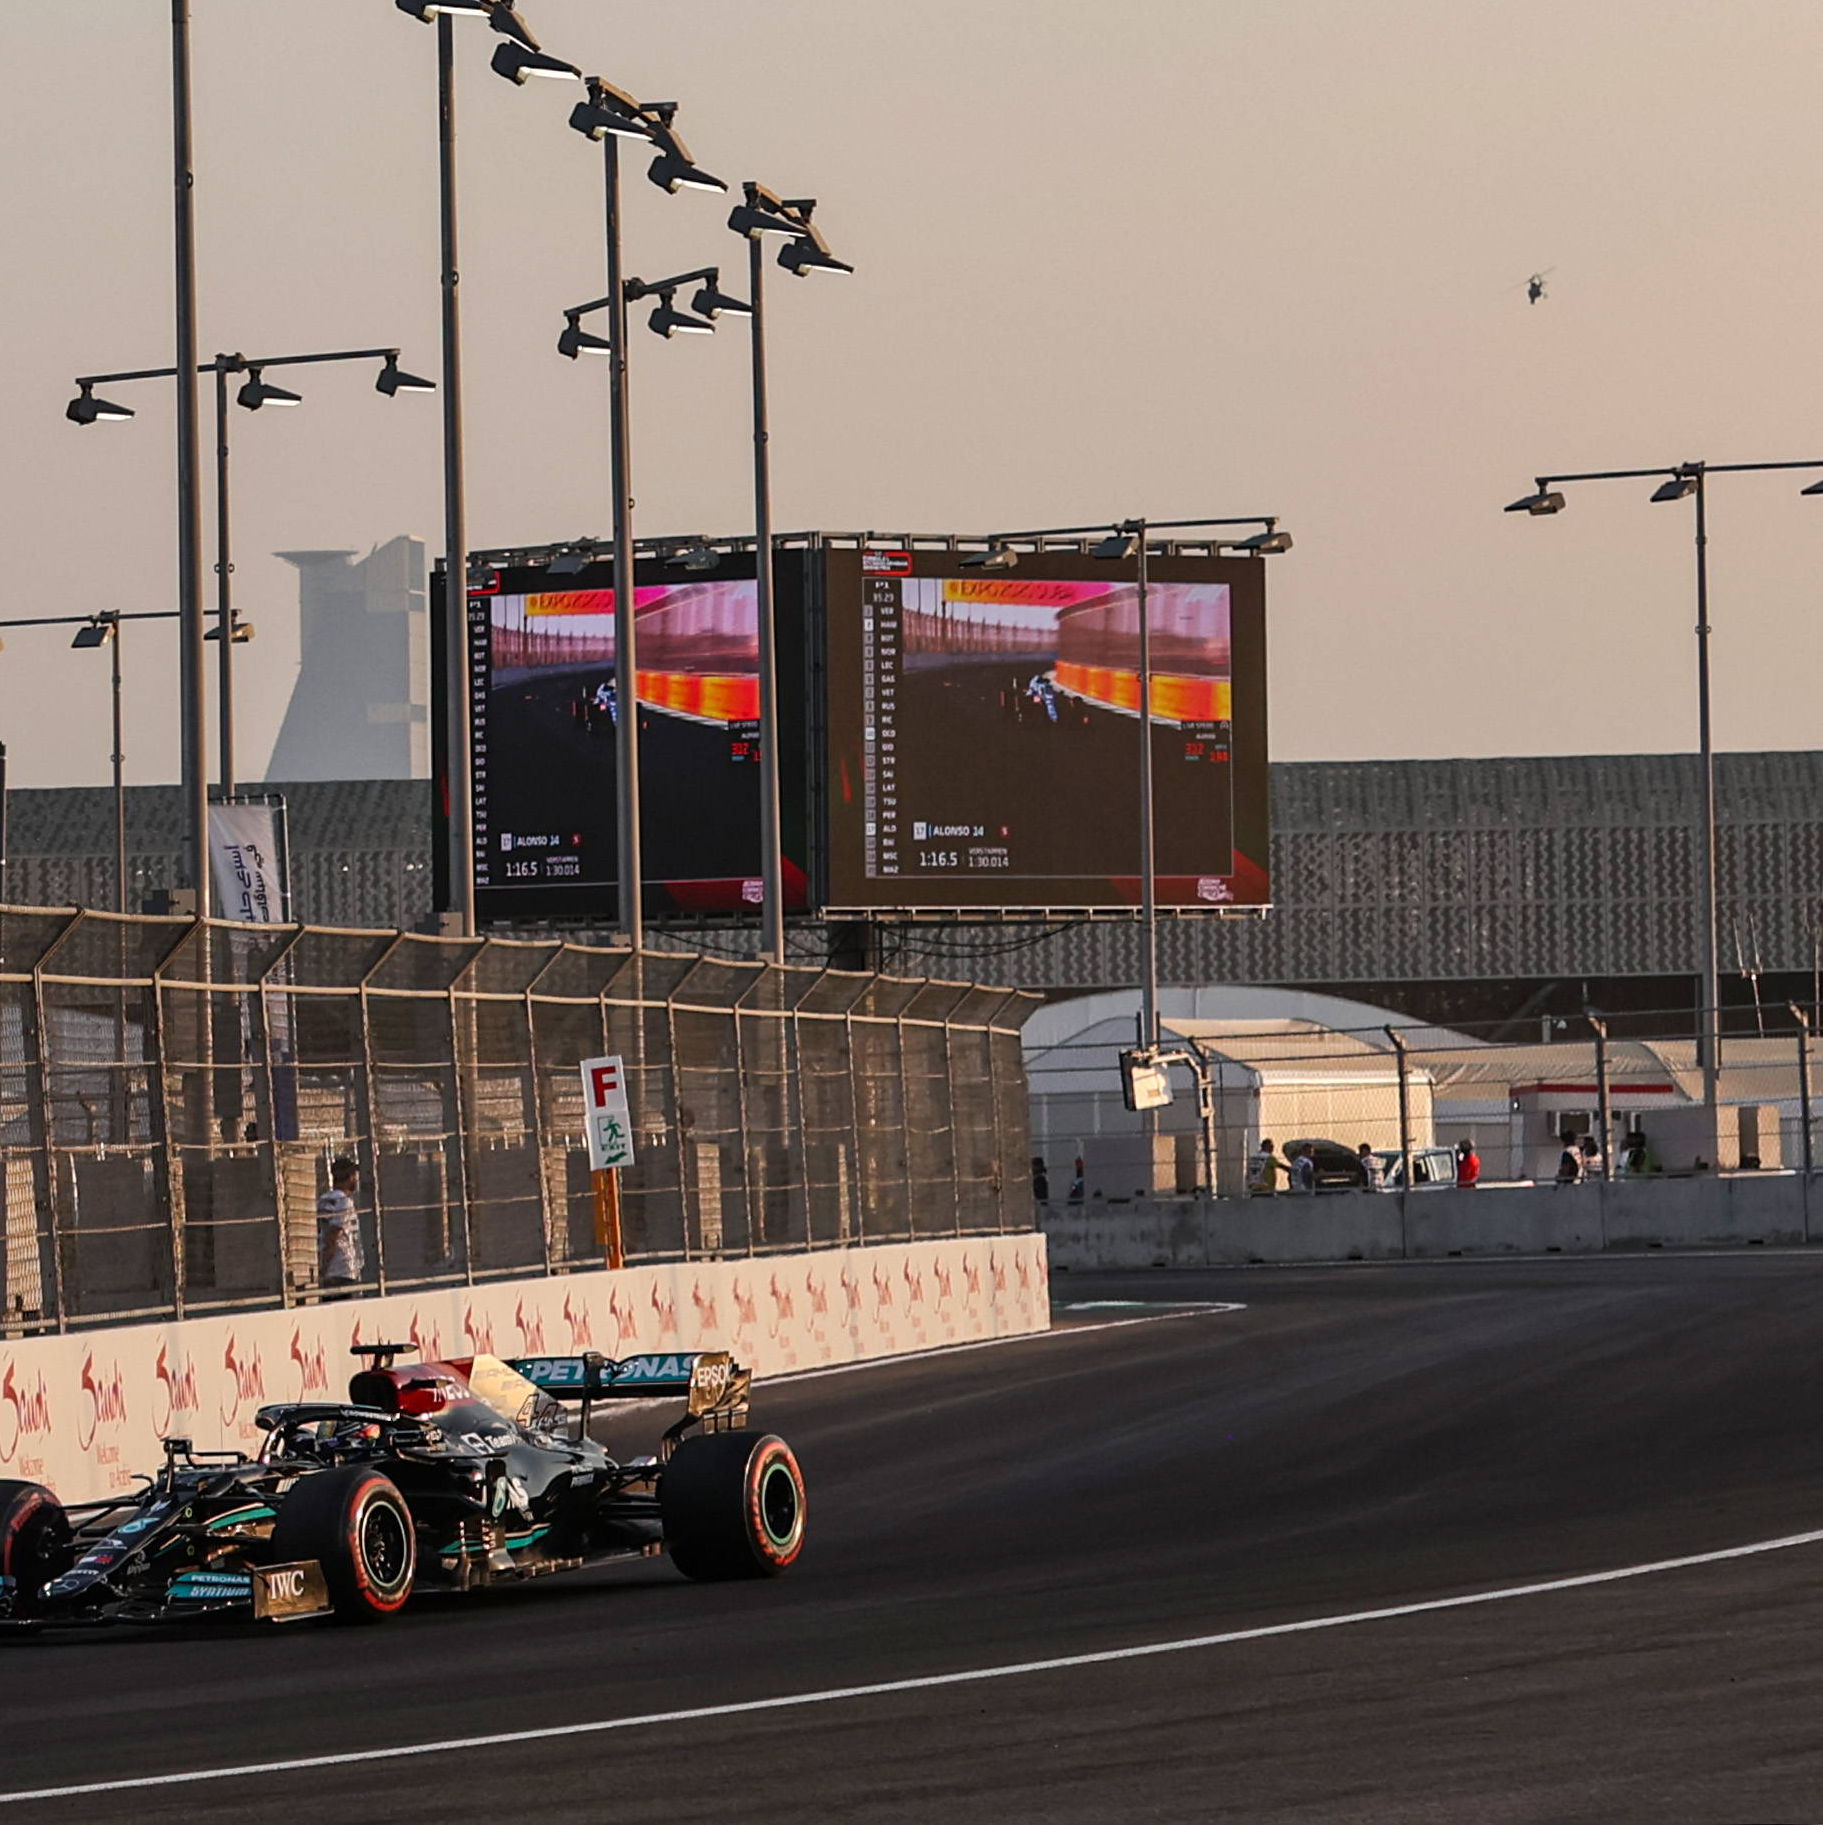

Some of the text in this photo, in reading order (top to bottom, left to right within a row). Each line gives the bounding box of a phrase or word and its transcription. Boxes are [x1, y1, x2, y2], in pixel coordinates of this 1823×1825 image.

[932, 826, 970, 836] ALONSO
[972, 826, 984, 837] 14
[516, 836, 548, 846] ALONSO
[549, 835, 560, 846] 14
[920, 851, 958, 866] 1:16.5
[968, 856, 1009, 868] 1:30.014
[506, 861, 538, 877] 1:16.5
[591, 1066, 617, 1107] F
[191, 1574, 251, 1584] PETRONAS
[270, 1569, 305, 1600] IWC
